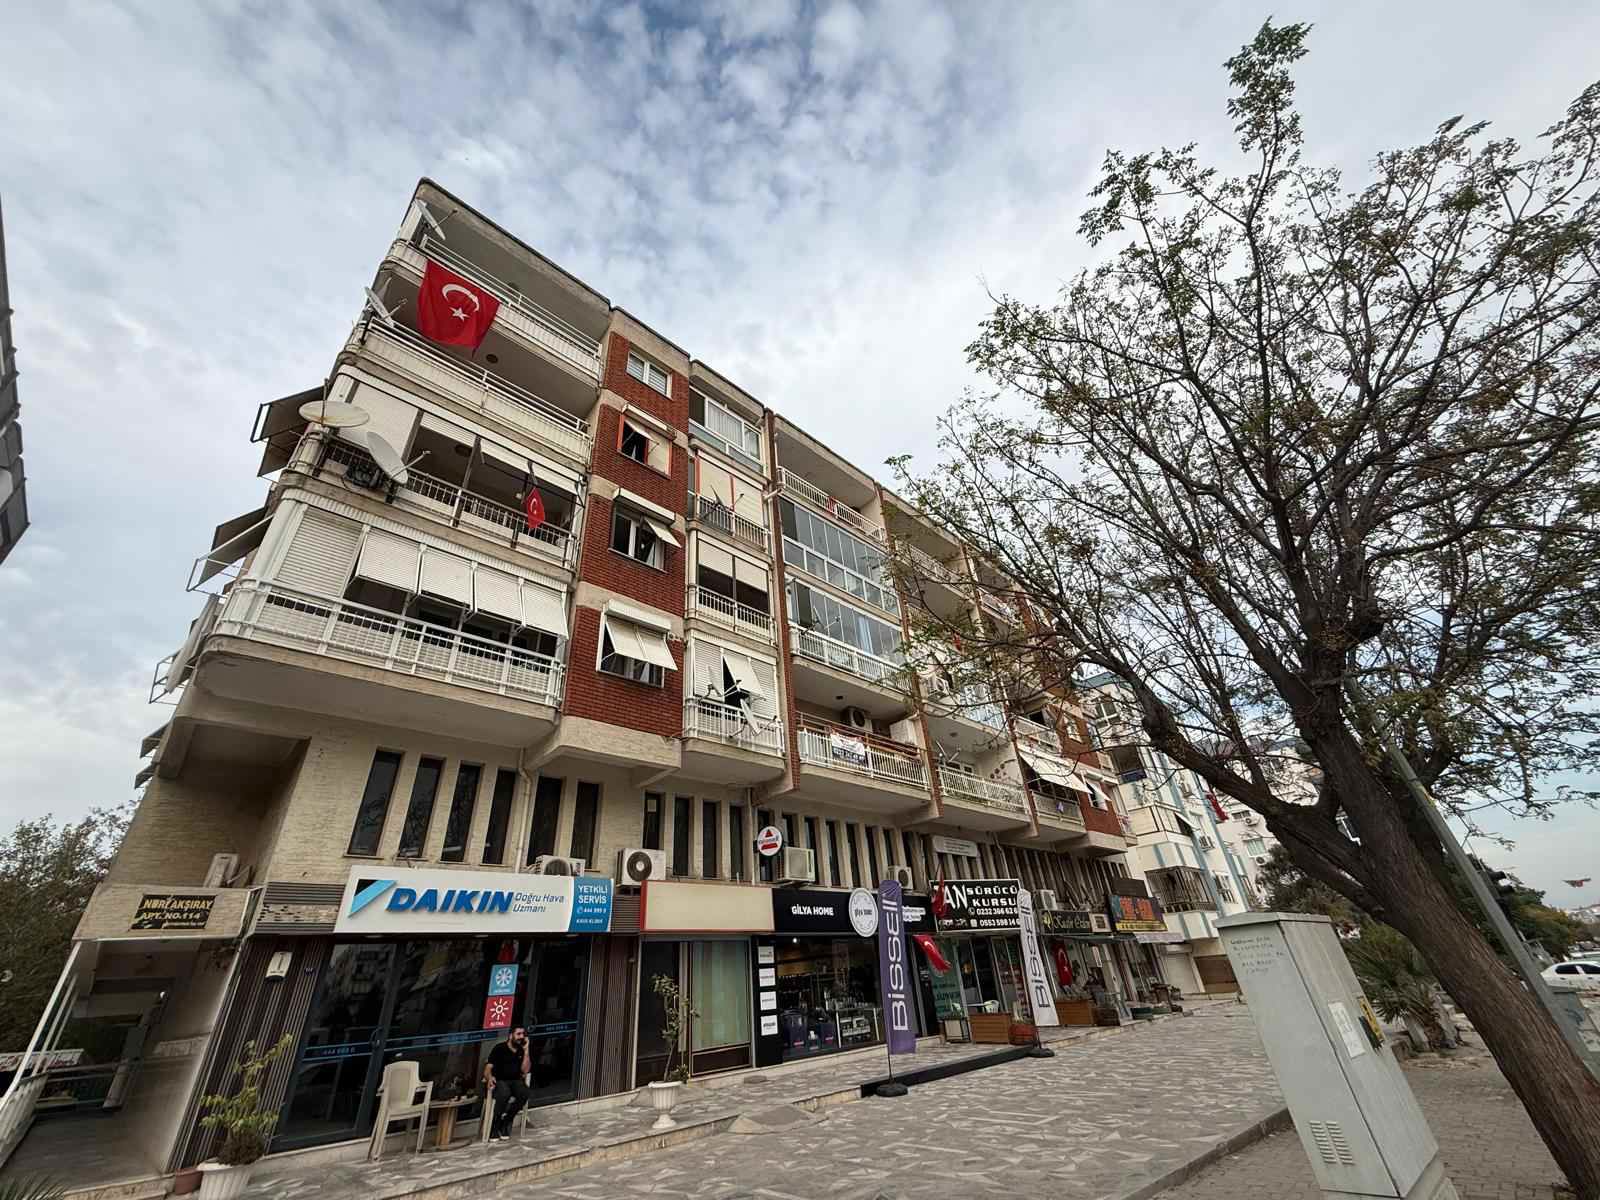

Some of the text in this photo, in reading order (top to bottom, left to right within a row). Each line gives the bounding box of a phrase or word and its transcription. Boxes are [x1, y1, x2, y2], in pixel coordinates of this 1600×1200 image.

[578, 885, 608, 893] YETKİLİ
[385, 887, 514, 913] DAIKIN
[514, 892, 565, 906] Doğru Hava
[578, 895, 607, 904] SERVİS
[933, 884, 1018, 909] AN SÜRÜCÜ
[972, 897, 1017, 907] KURSU
[512, 903, 546, 913] Uzmanı
[791, 903, 834, 916] GİLYA HOME
